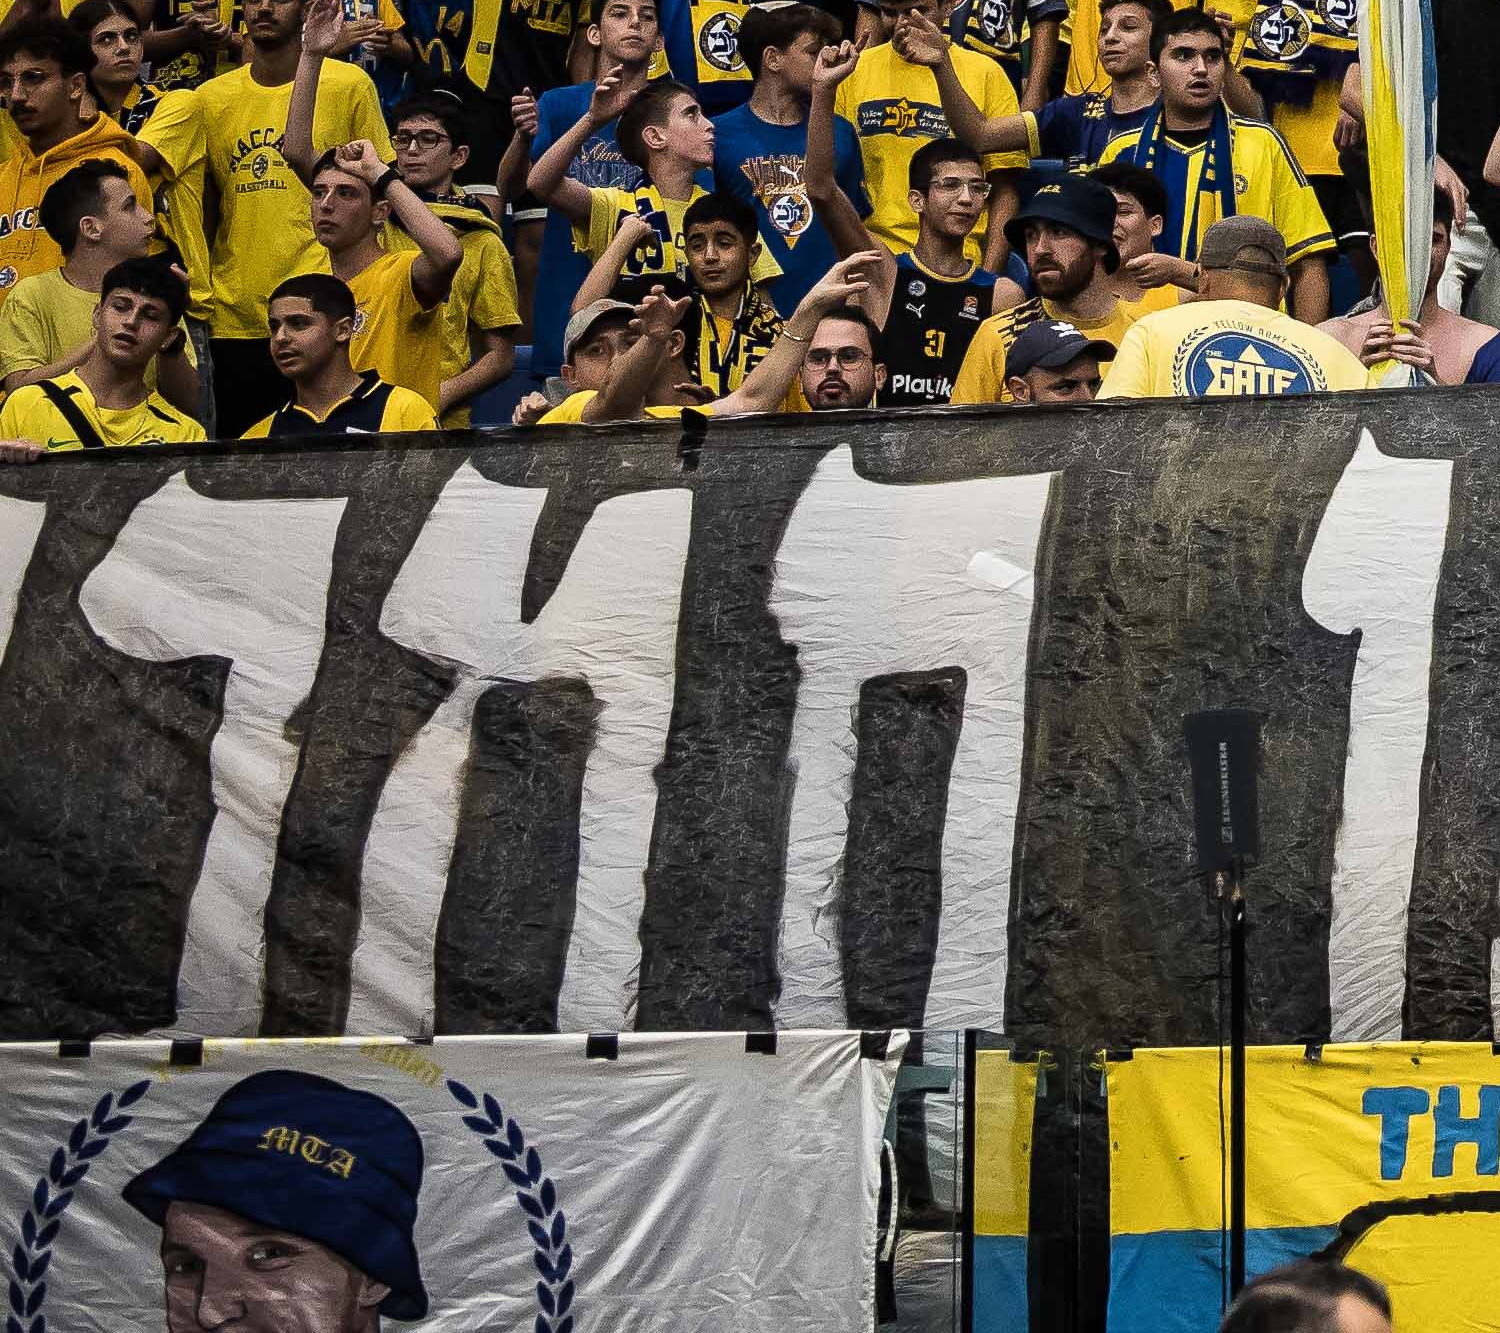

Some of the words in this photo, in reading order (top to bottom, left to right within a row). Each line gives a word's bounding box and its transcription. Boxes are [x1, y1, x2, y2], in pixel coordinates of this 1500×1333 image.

[1212, 318, 1256, 333] YELLOW
[924, 329, 945, 358] 31
[1208, 360, 1298, 396] GATE
[257, 1121, 359, 1184] MTA
